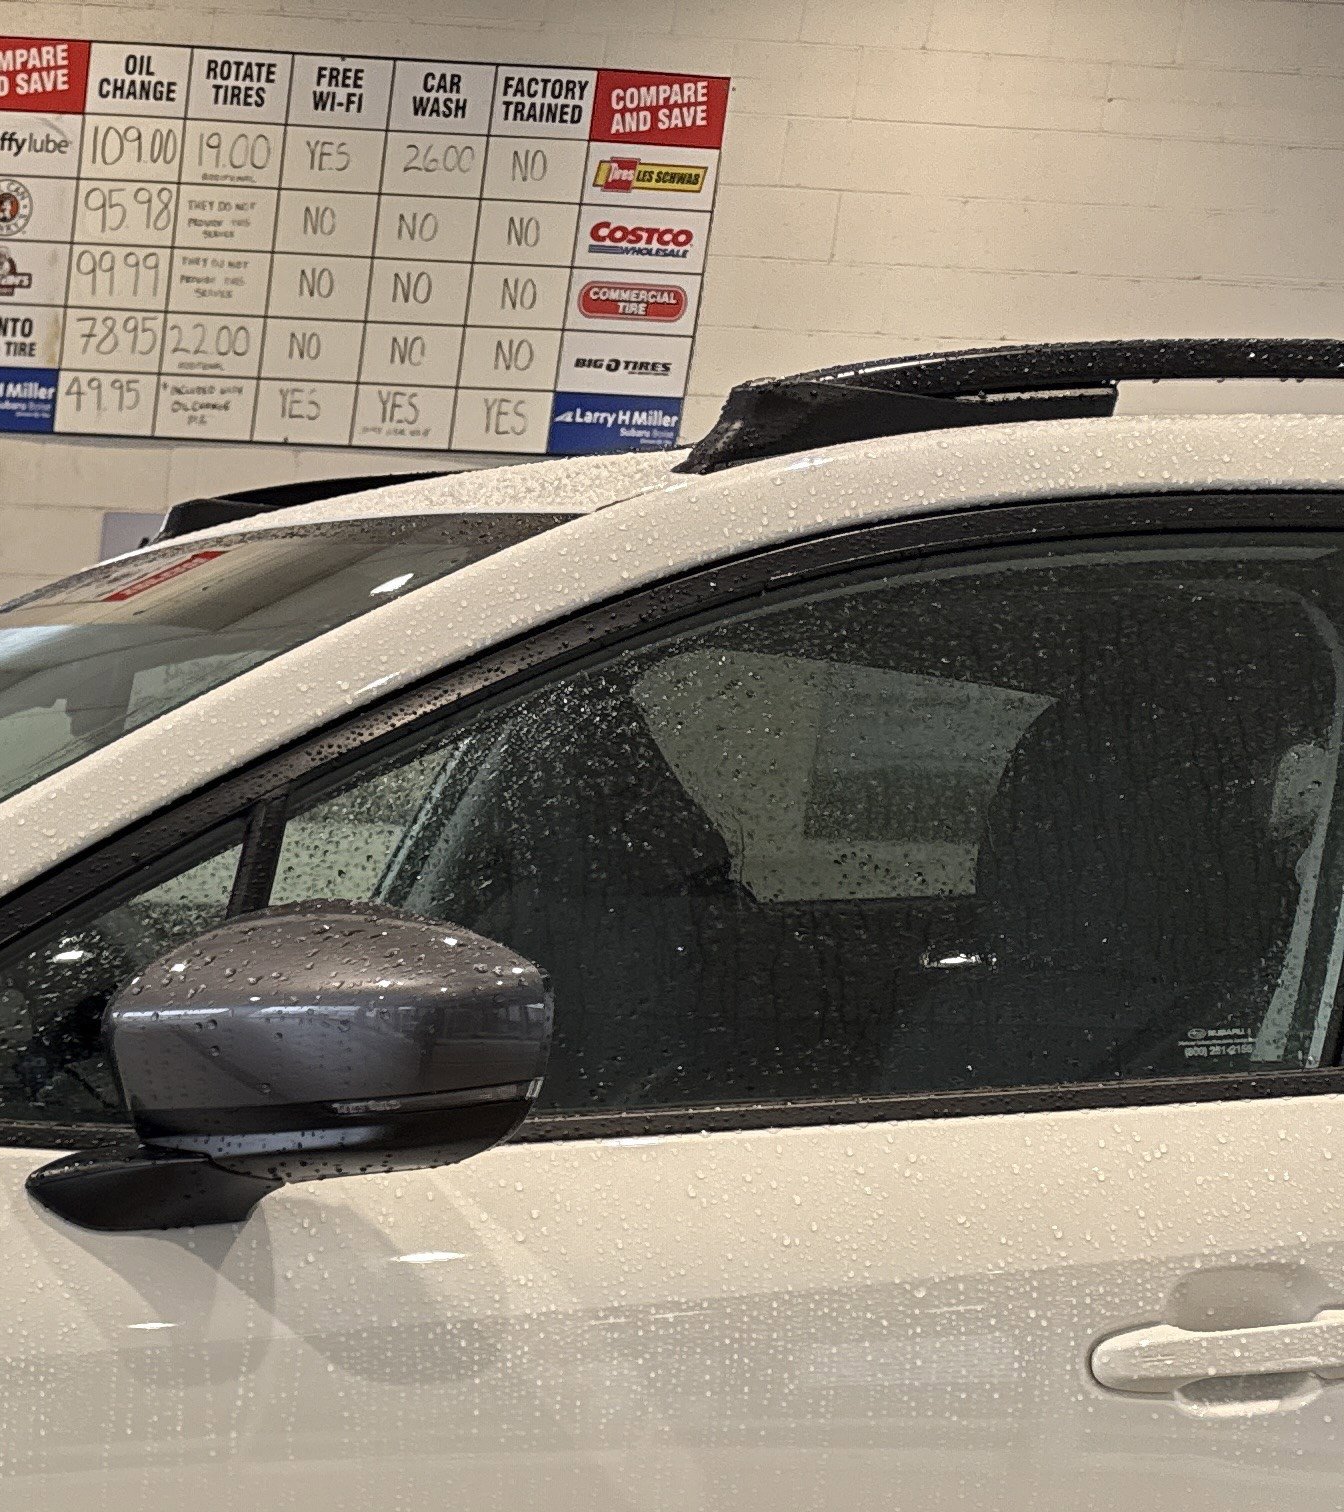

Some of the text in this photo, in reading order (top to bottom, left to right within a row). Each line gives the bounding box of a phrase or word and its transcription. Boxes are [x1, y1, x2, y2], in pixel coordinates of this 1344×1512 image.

[124, 54, 155, 76] OIL
[206, 59, 277, 84] ROTATE
[316, 66, 364, 89] FREE
[15, 69, 69, 96] SAVE
[98, 78, 177, 102] CHANGE
[422, 72, 462, 94] CAR
[502, 76, 589, 100] FACTORY
[212, 84, 266, 108] TIRES
[312, 90, 363, 114] WI-FI
[412, 96, 467, 119] WASH
[611, 81, 708, 110] COMPARE
[502, 101, 583, 125] TRAINED
[611, 106, 708, 134] AND SAVE
[305, 139, 351, 172] YES
[512, 149, 548, 182] NO
[636, 169, 654, 183] LES
[655, 170, 700, 186] SCHWAB
[302, 206, 336, 236] NO
[397, 212, 439, 243] NO
[506, 216, 541, 247] NO
[590, 221, 693, 247] COSTCO
[622, 246, 689, 259] WHOLESALE
[298, 268, 335, 299] NO
[391, 271, 433, 304] NO
[500, 277, 537, 310] NO
[589, 287, 677, 304] COMMERCIAL
[617, 301, 647, 315] TIRE
[4, 341, 36, 358] TIRE
[288, 332, 321, 360] NO
[390, 336, 426, 366] NO
[493, 339, 534, 371] NO
[574, 358, 604, 369] BIG
[623, 360, 672, 372] TIRES
[6, 382, 55, 400] Miller
[279, 387, 321, 420] YES
[377, 390, 419, 425] YES
[483, 397, 527, 436] YES
[575, 407, 678, 428] Larry H Miller
